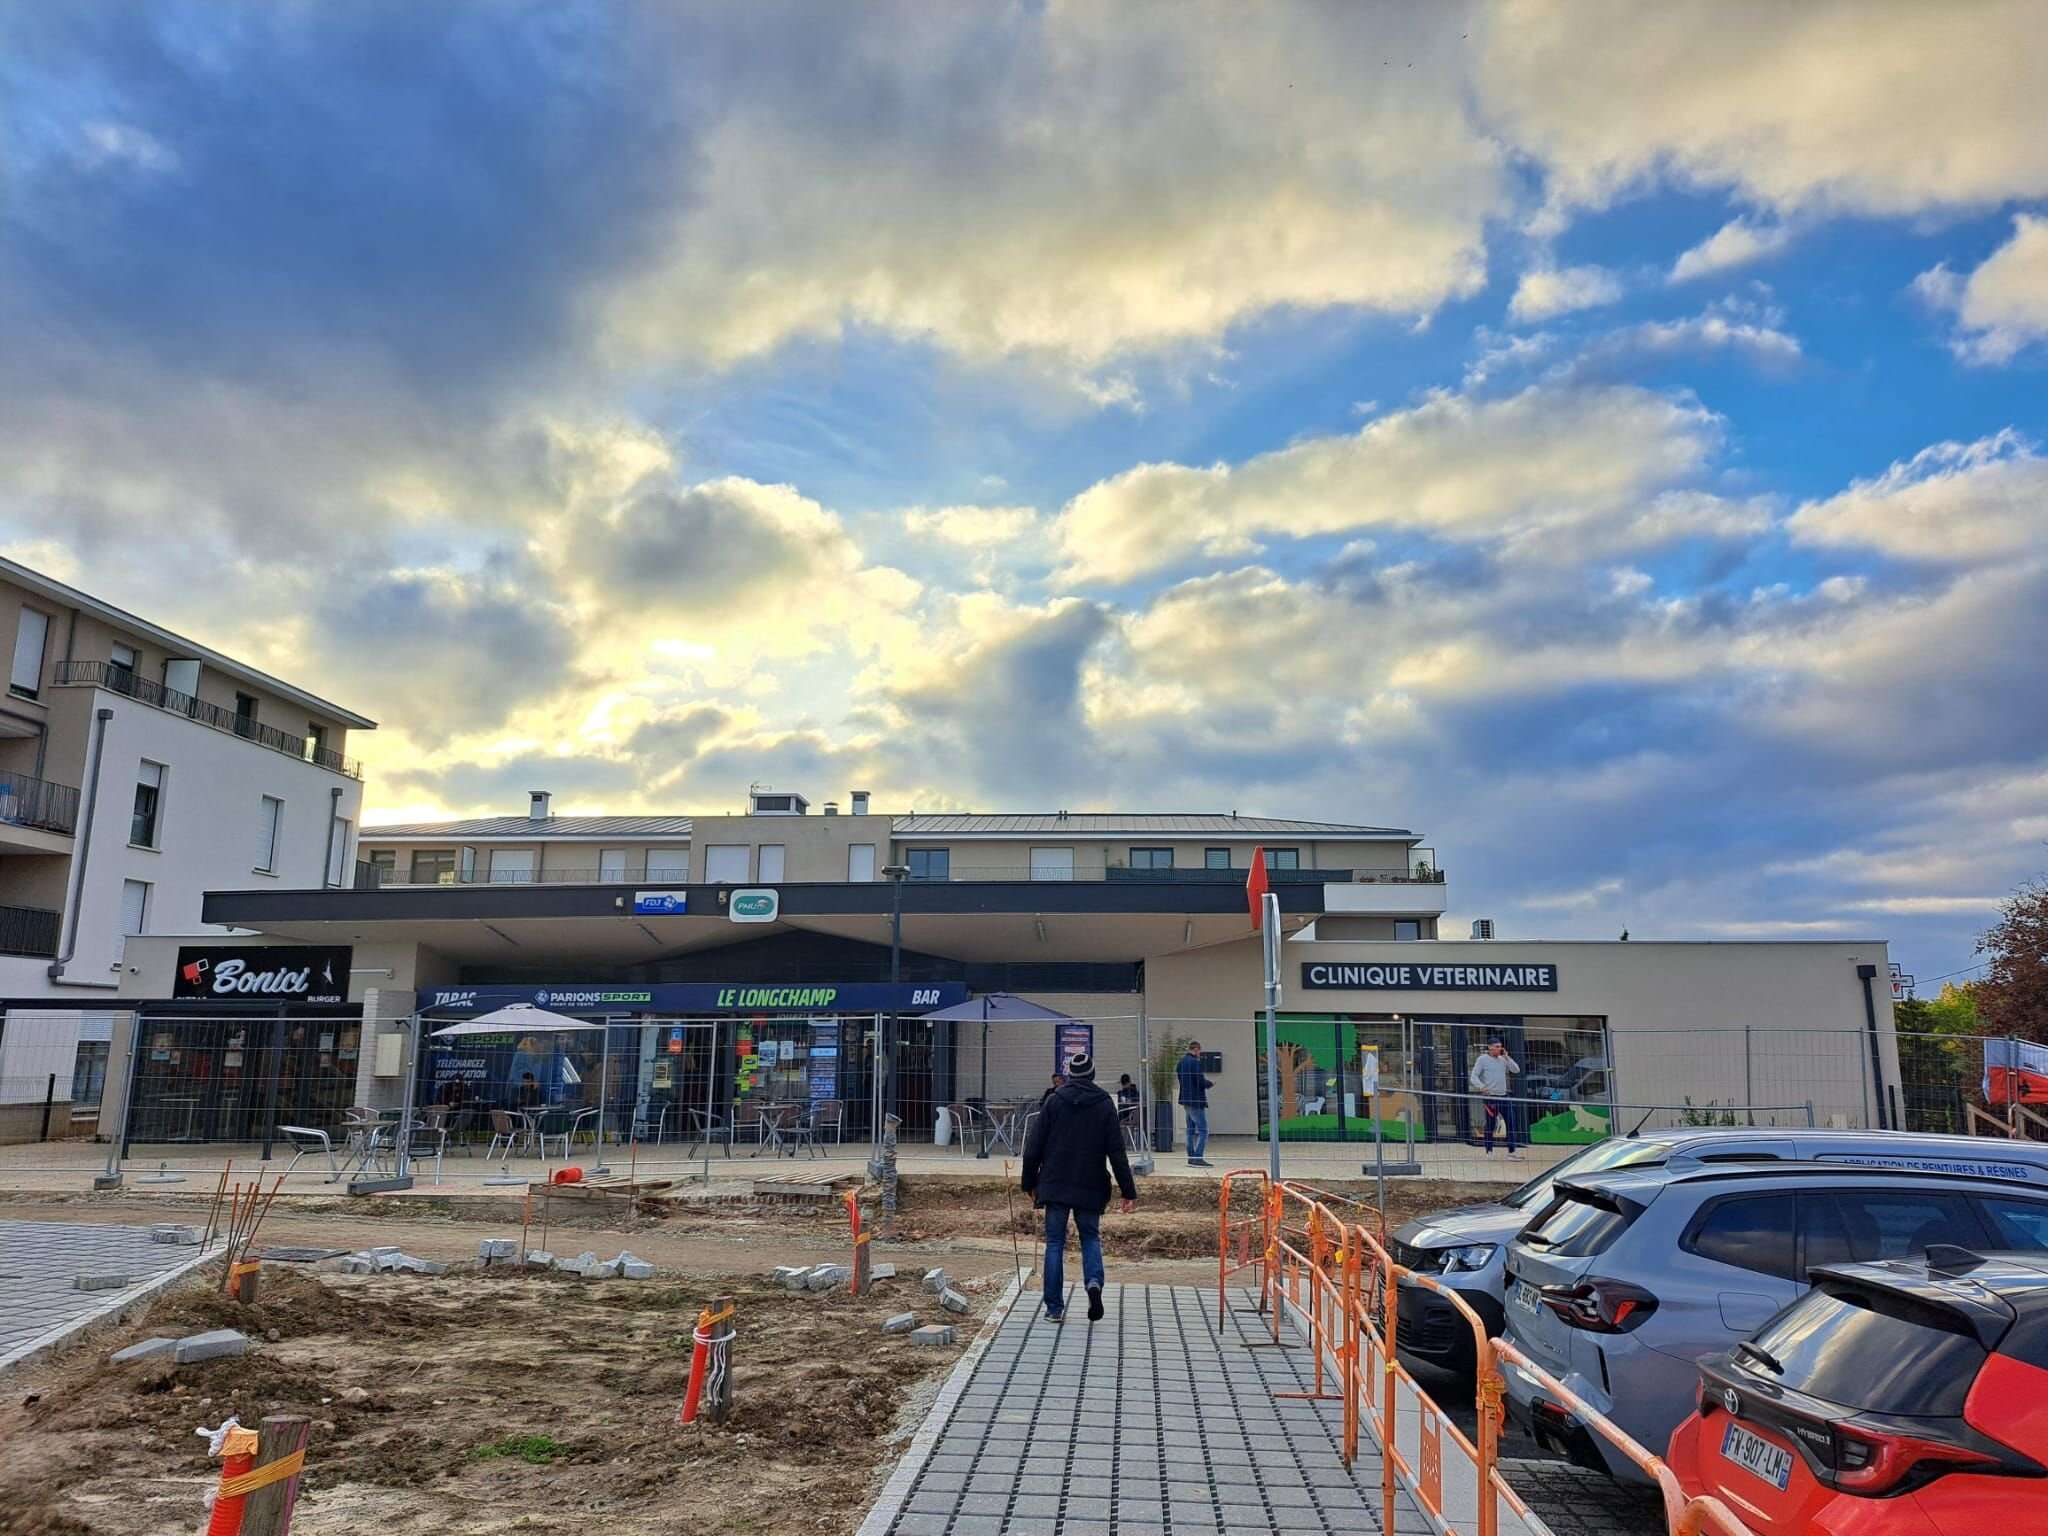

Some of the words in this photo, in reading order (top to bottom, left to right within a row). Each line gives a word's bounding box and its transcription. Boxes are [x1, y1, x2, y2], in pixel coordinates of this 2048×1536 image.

[645, 898, 662, 906] FDJ
[738, 902, 757, 910] PMU
[212, 959, 310, 993] Bonici
[1310, 966, 1410, 986] CLINIQUE
[1416, 967, 1550, 986] VETERINAIRE
[307, 995, 341, 1003] BURGER
[435, 991, 477, 1007] TABAC
[550, 992, 600, 1002] PARIONS
[603, 993, 650, 1001] SPORT
[716, 989, 736, 1007] LE
[738, 988, 837, 1007] LONGCHAMP
[911, 989, 941, 1004] BAR
[461, 1034, 514, 1044] SPORT
[435, 1069, 488, 1079] L'APPCATION
